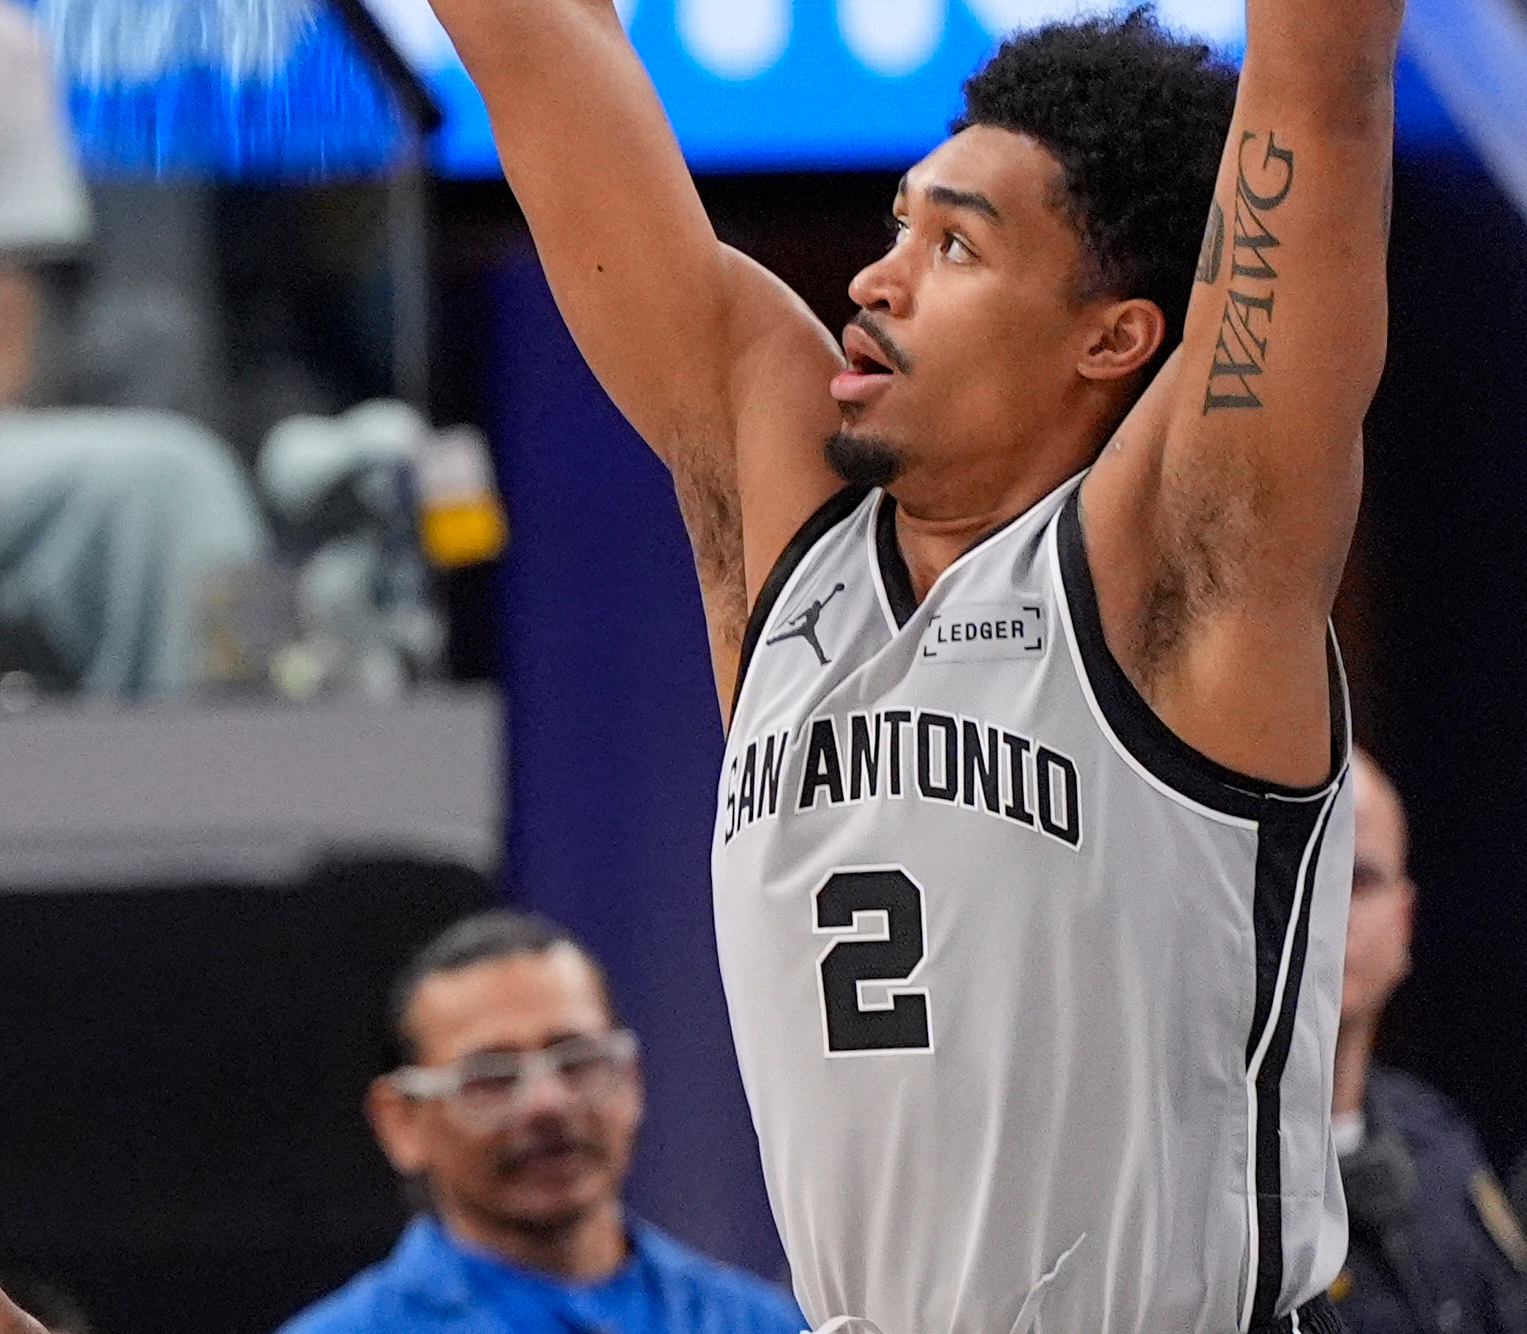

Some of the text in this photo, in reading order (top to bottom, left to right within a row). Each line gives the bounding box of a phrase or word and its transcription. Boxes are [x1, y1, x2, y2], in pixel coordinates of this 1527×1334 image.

[936, 619, 1026, 644] LEDGER
[724, 707, 1083, 853] SAN ANTONIO
[811, 863, 935, 1058] 2
